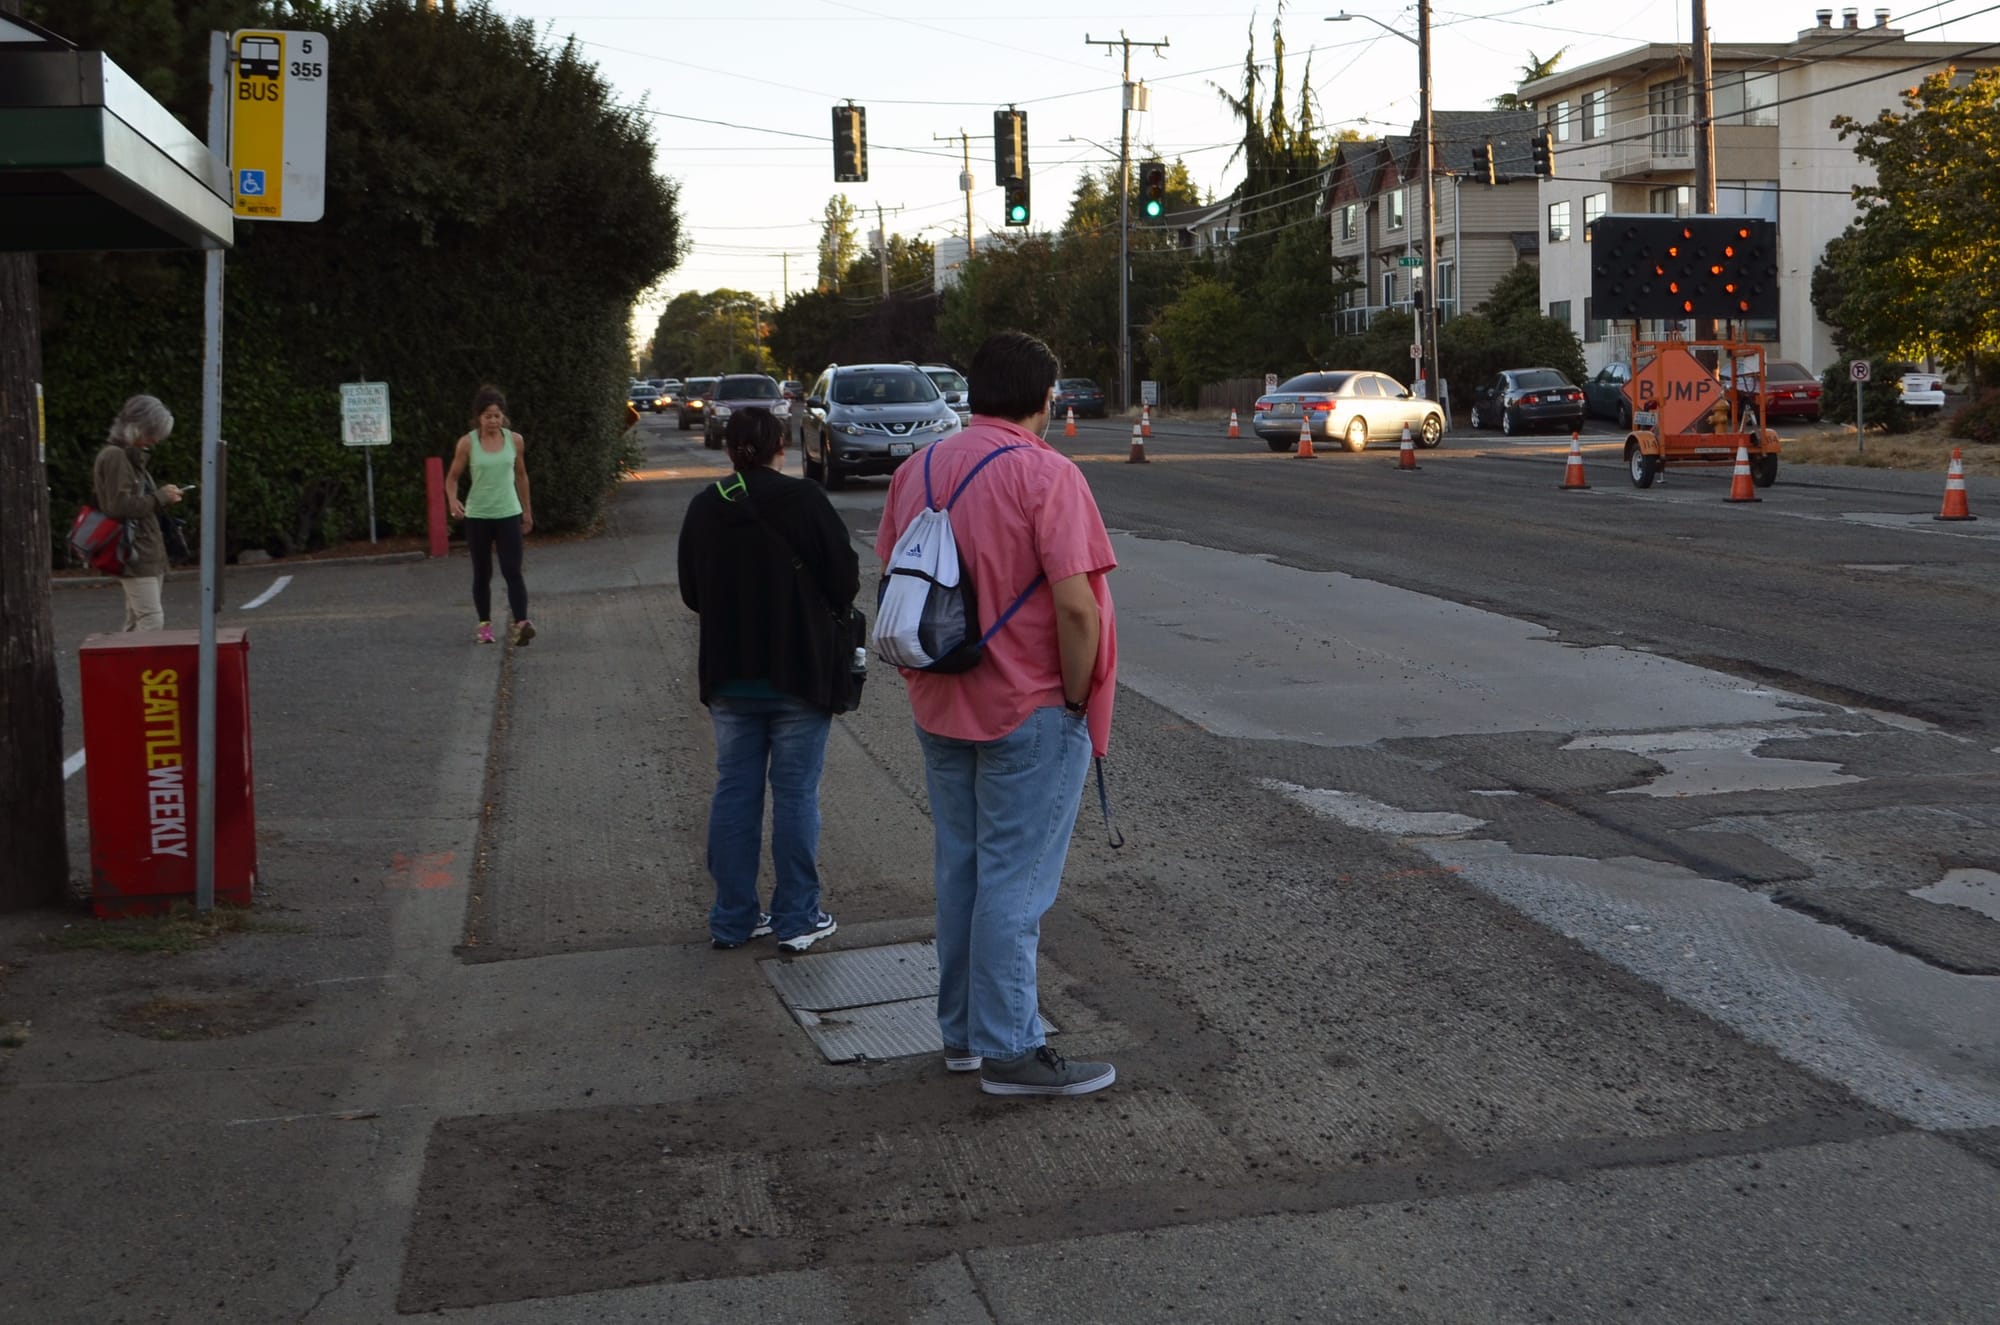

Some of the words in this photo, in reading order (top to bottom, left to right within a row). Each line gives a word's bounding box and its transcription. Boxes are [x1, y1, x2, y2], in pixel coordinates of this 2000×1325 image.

[302, 40, 312, 54] 5
[291, 62, 322, 77] 355
[239, 82, 278, 101] BUS
